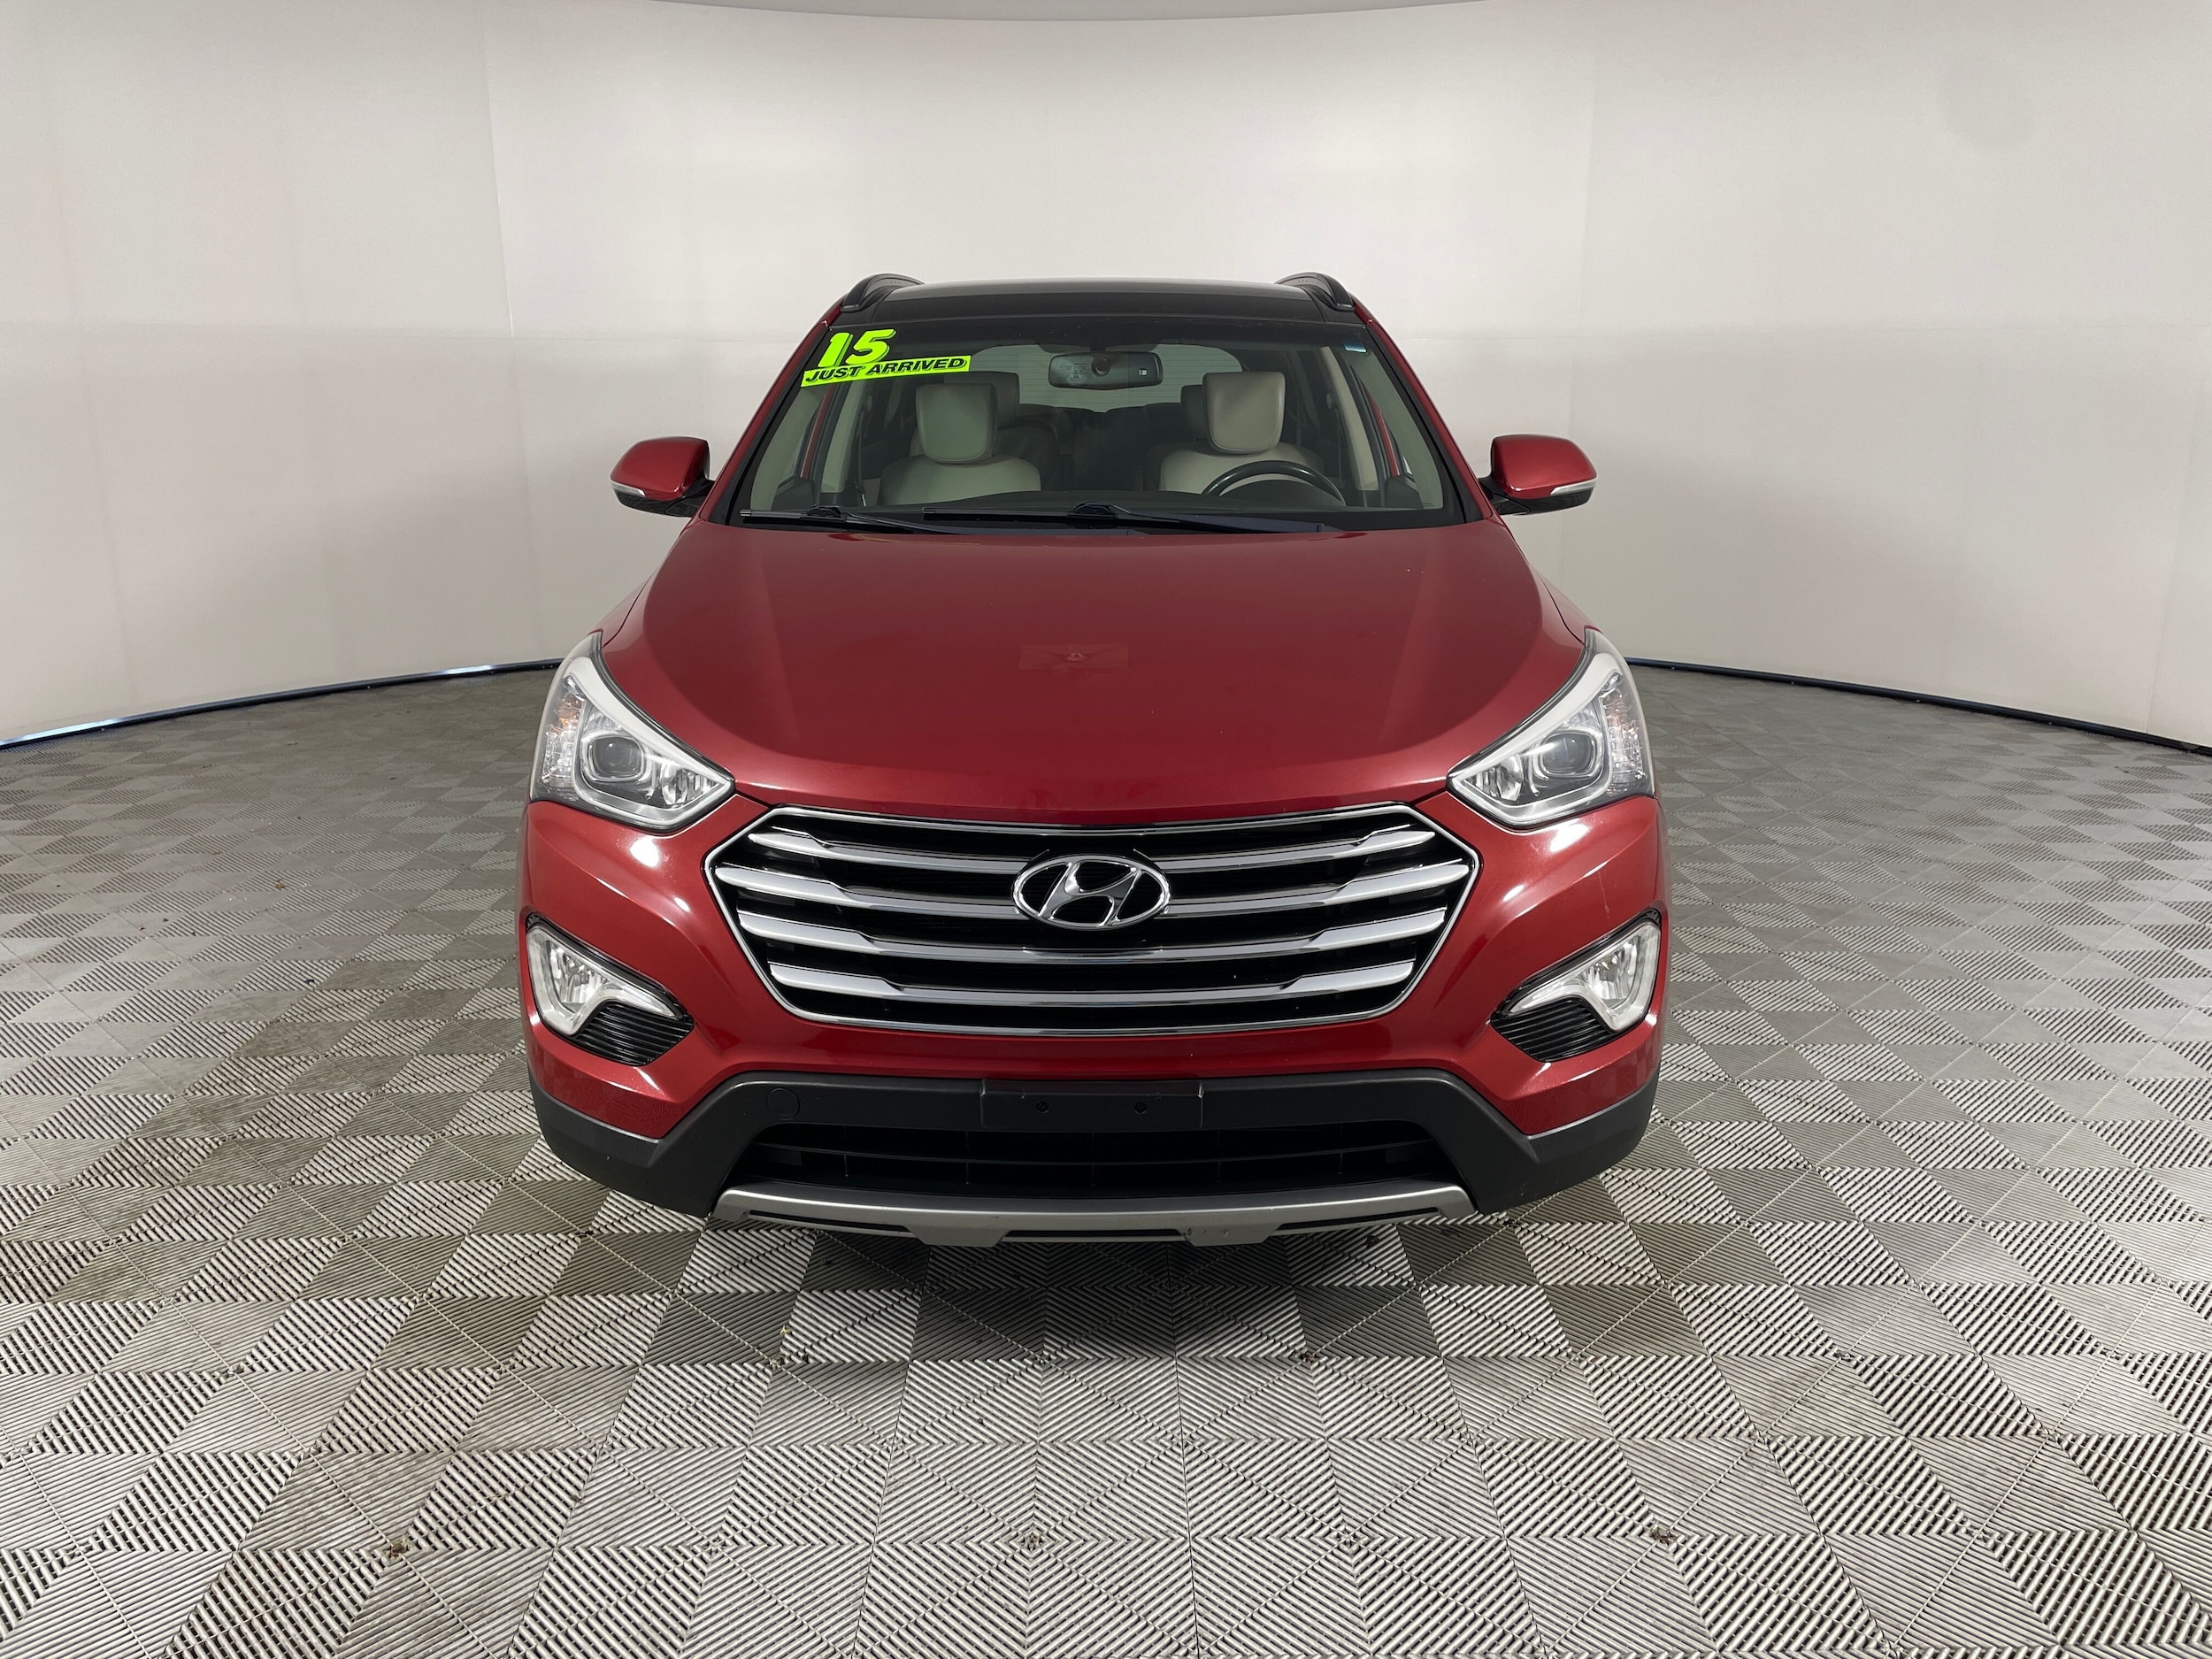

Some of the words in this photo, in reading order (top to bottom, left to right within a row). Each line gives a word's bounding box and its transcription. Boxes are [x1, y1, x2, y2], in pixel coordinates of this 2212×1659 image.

[818, 328, 897, 368] 15
[805, 365, 864, 382] JUST
[866, 357, 966, 375] ARRIVED
